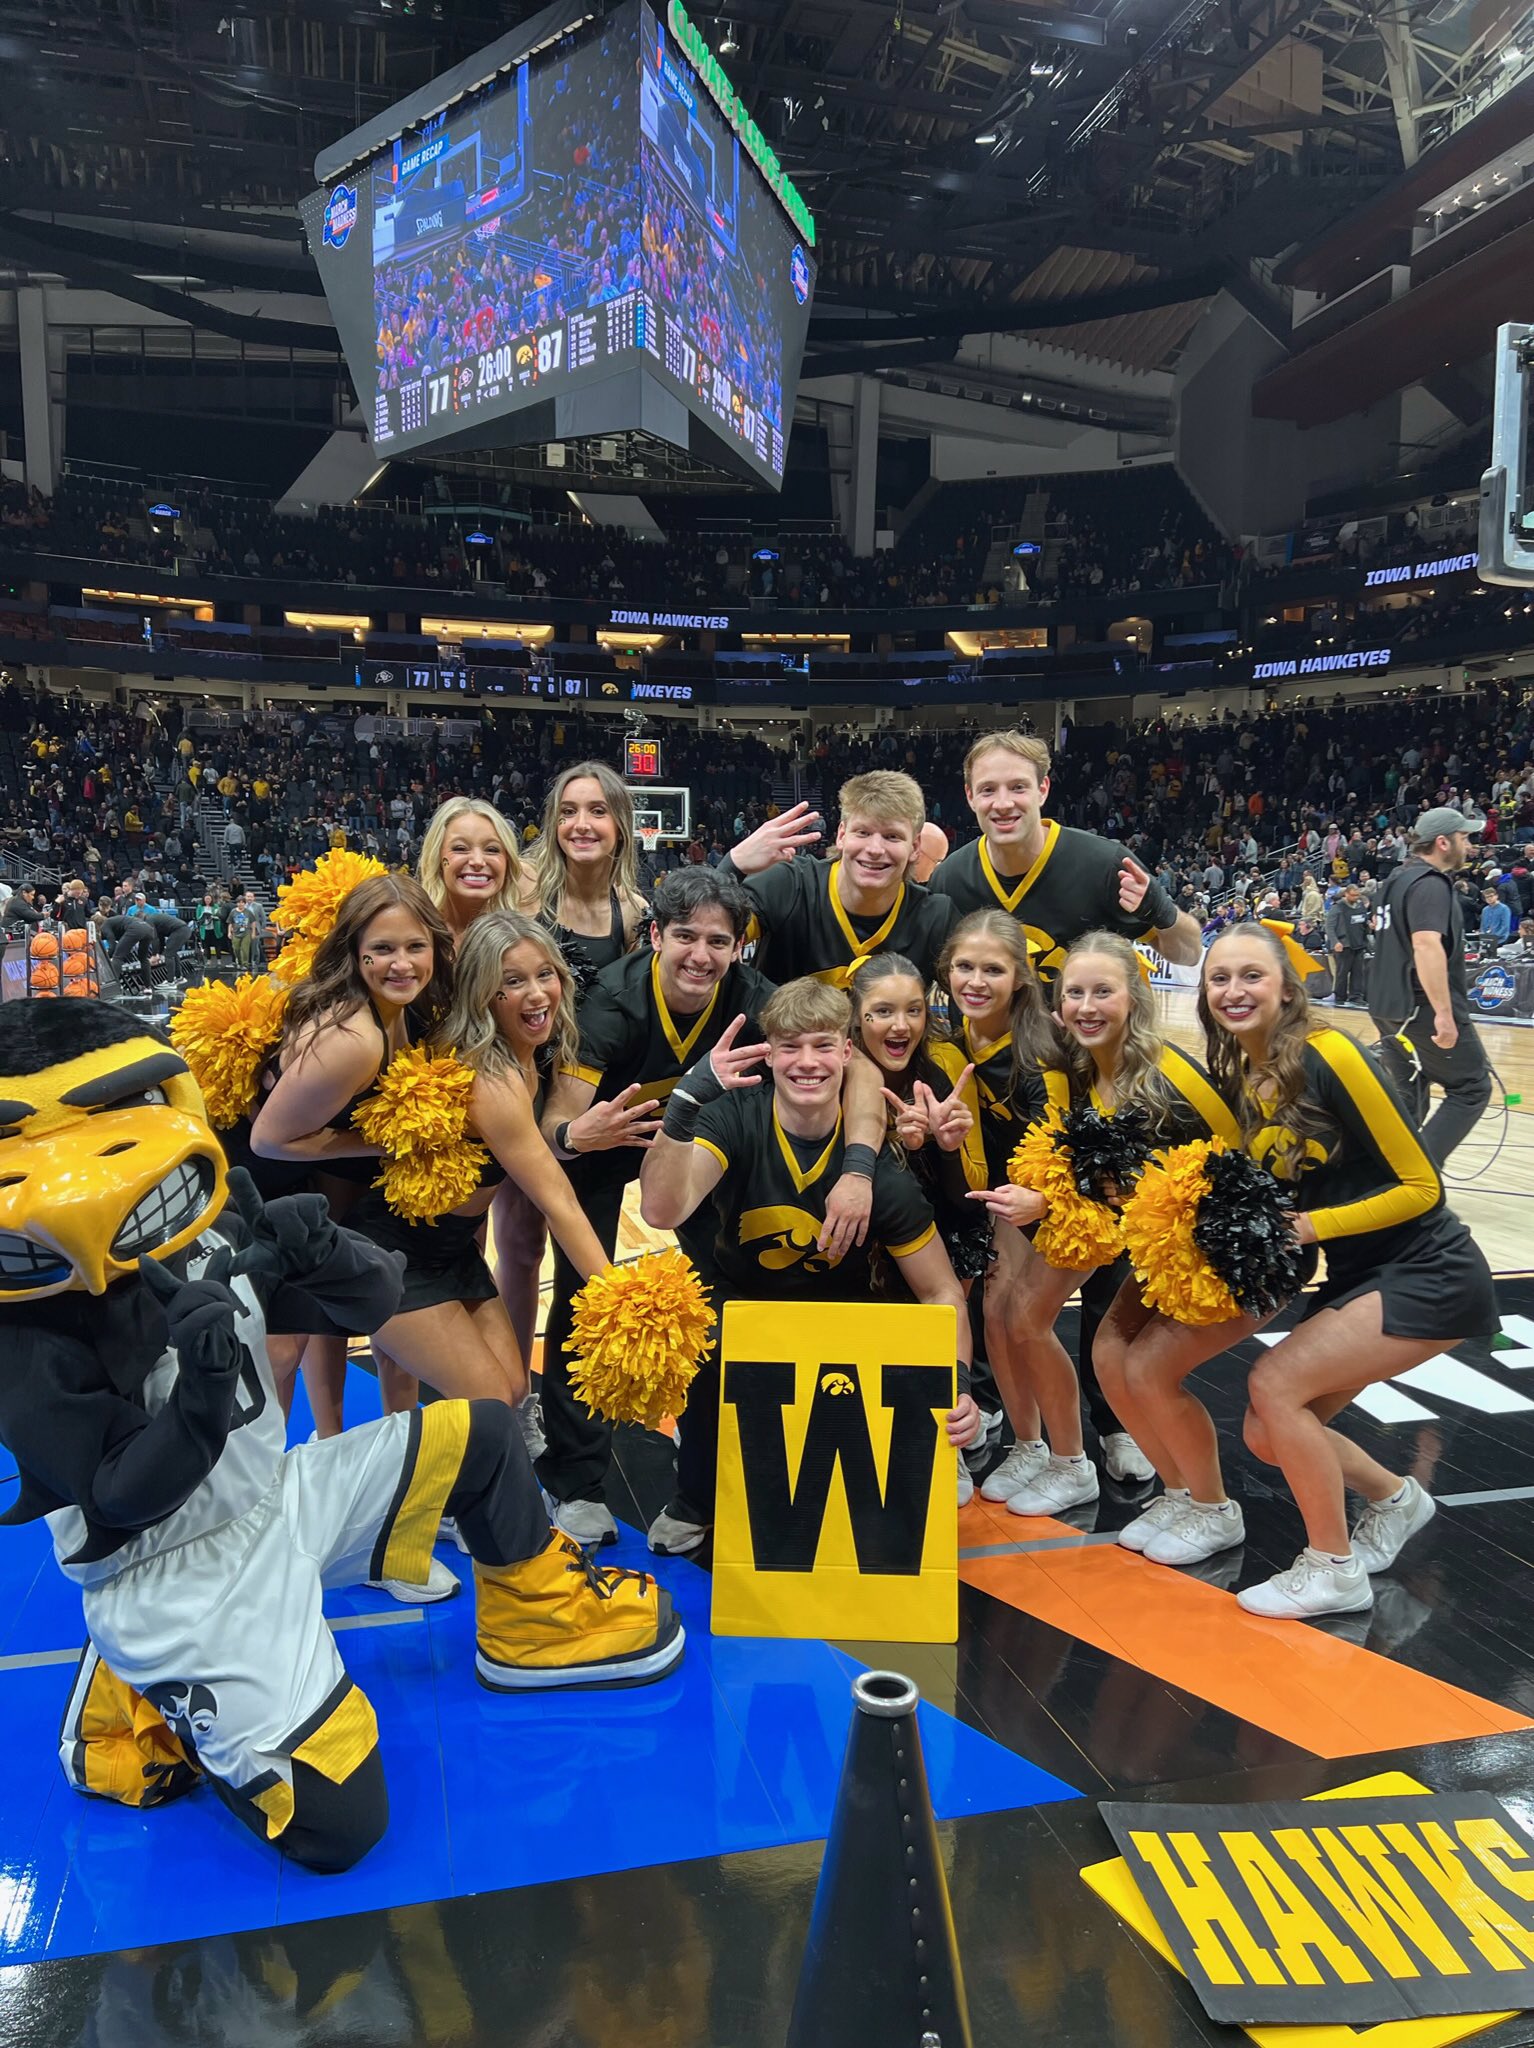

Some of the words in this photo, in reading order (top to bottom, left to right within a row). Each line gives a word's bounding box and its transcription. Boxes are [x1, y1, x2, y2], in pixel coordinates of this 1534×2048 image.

[402, 154, 421, 175] GAME
[421, 140, 443, 164] RECAP
[416, 210, 443, 236] SPALDING
[429, 375, 450, 415] 77
[478, 345, 511, 388] 26:00
[538, 329, 563, 374] 87
[682, 340, 696, 385] 77
[1364, 565, 1411, 587] IOWA
[610, 610, 650, 625] IOWA
[652, 613, 730, 629] HAWKEYES
[1252, 661, 1297, 679] IOWA
[1299, 649, 1392, 674] HAWKEYES
[413, 671, 430, 687] 77
[565, 679, 581, 695] 87
[634, 683, 693, 699] WKEYES
[444, 678, 451, 689] 5
[459, 678, 467, 689] 0
[531, 683, 538, 693] 4
[548, 684, 554, 694] 0
[628, 743, 657, 754] 26:00
[632, 754, 654, 772] 30
[723, 1360, 953, 1577] W
[1128, 1818, 1534, 1985] HAWKS
